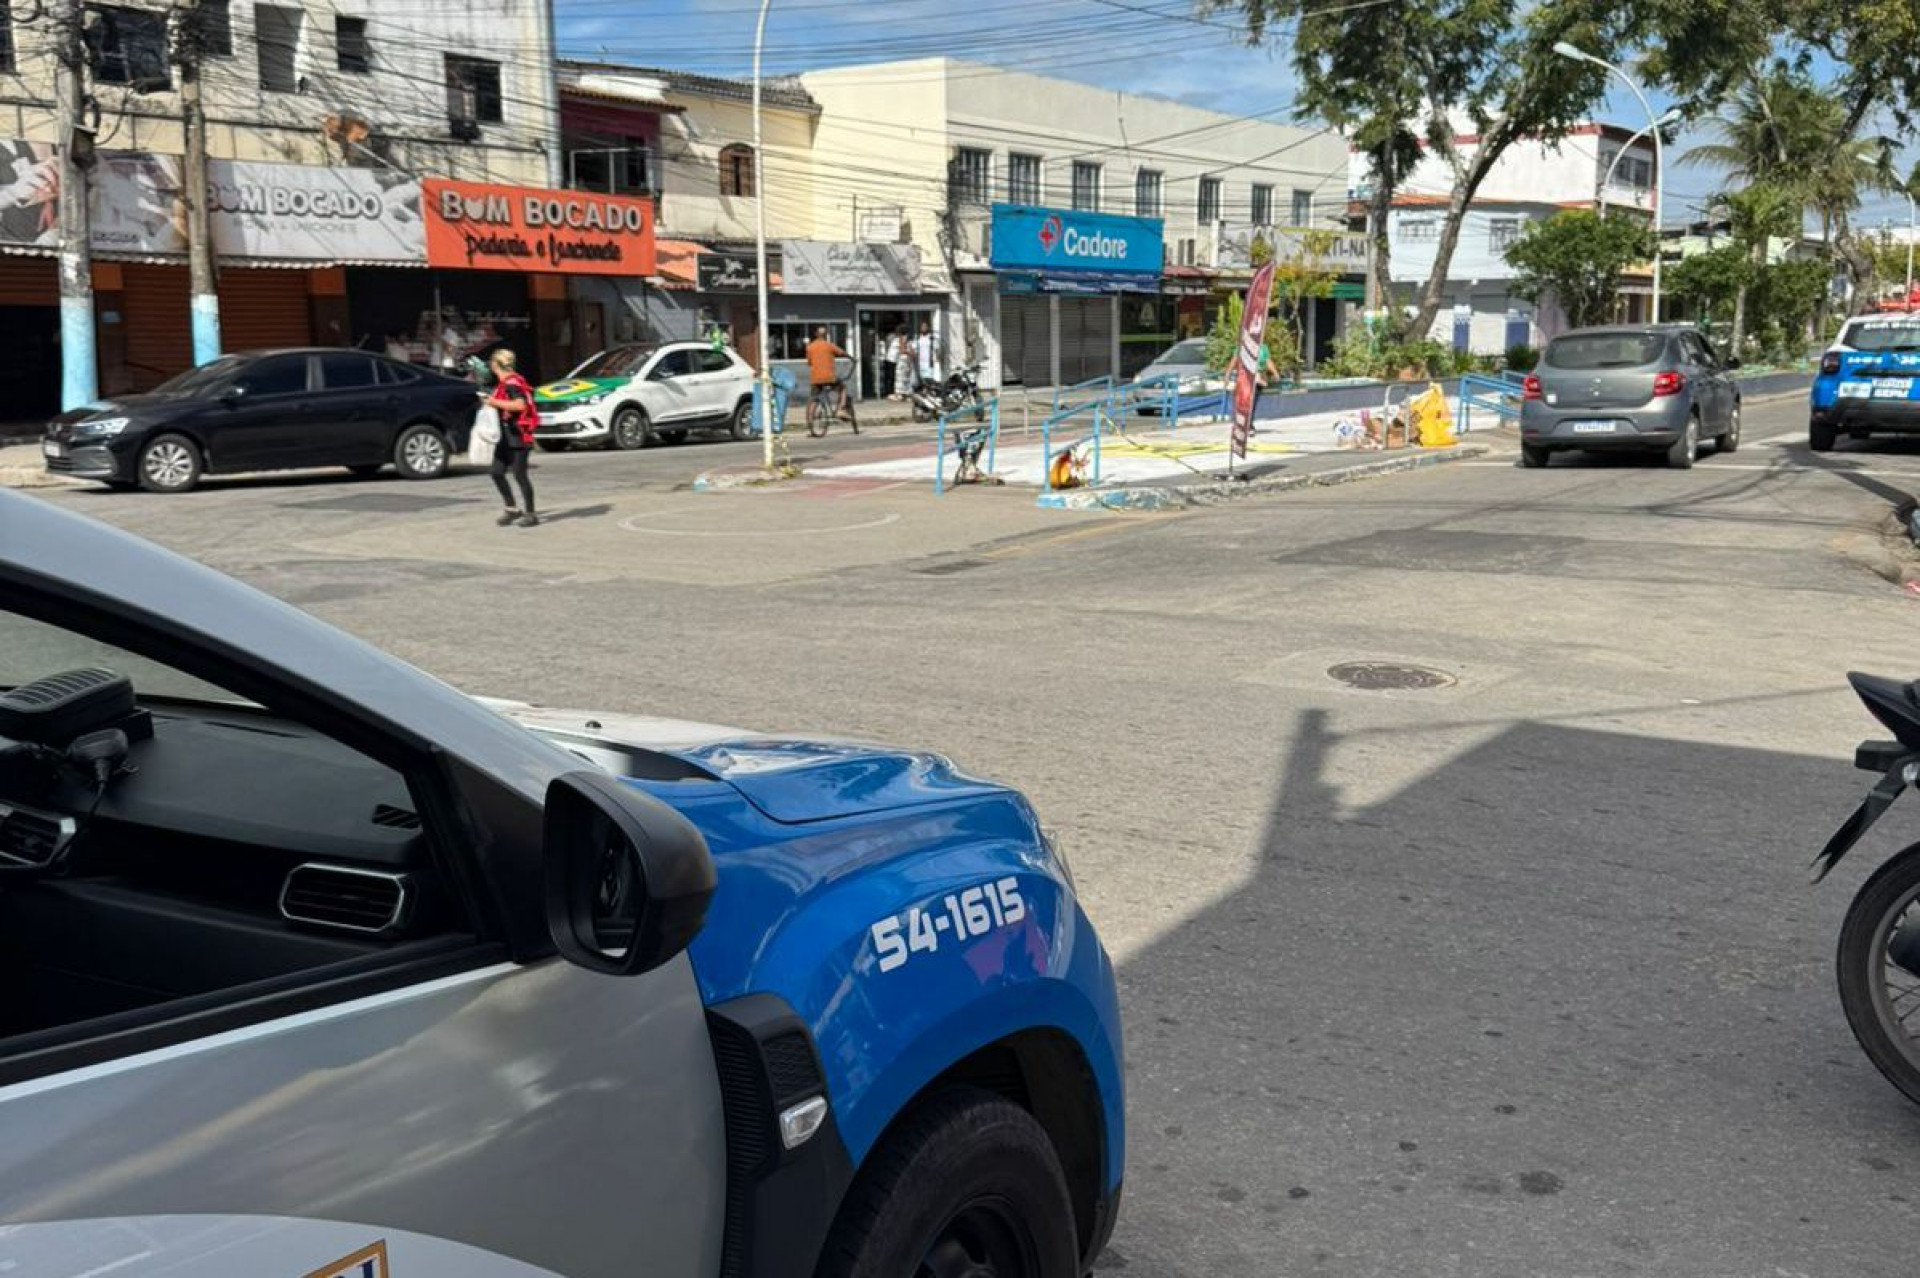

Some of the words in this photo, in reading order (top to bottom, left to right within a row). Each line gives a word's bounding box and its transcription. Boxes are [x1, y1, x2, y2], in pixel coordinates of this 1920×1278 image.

[271, 186, 383, 219] BOCADO
[440, 190, 510, 225] BOM
[524, 196, 643, 233] BOCADO
[1063, 226, 1128, 260] Cadore
[871, 876, 1025, 973] 54-1615
